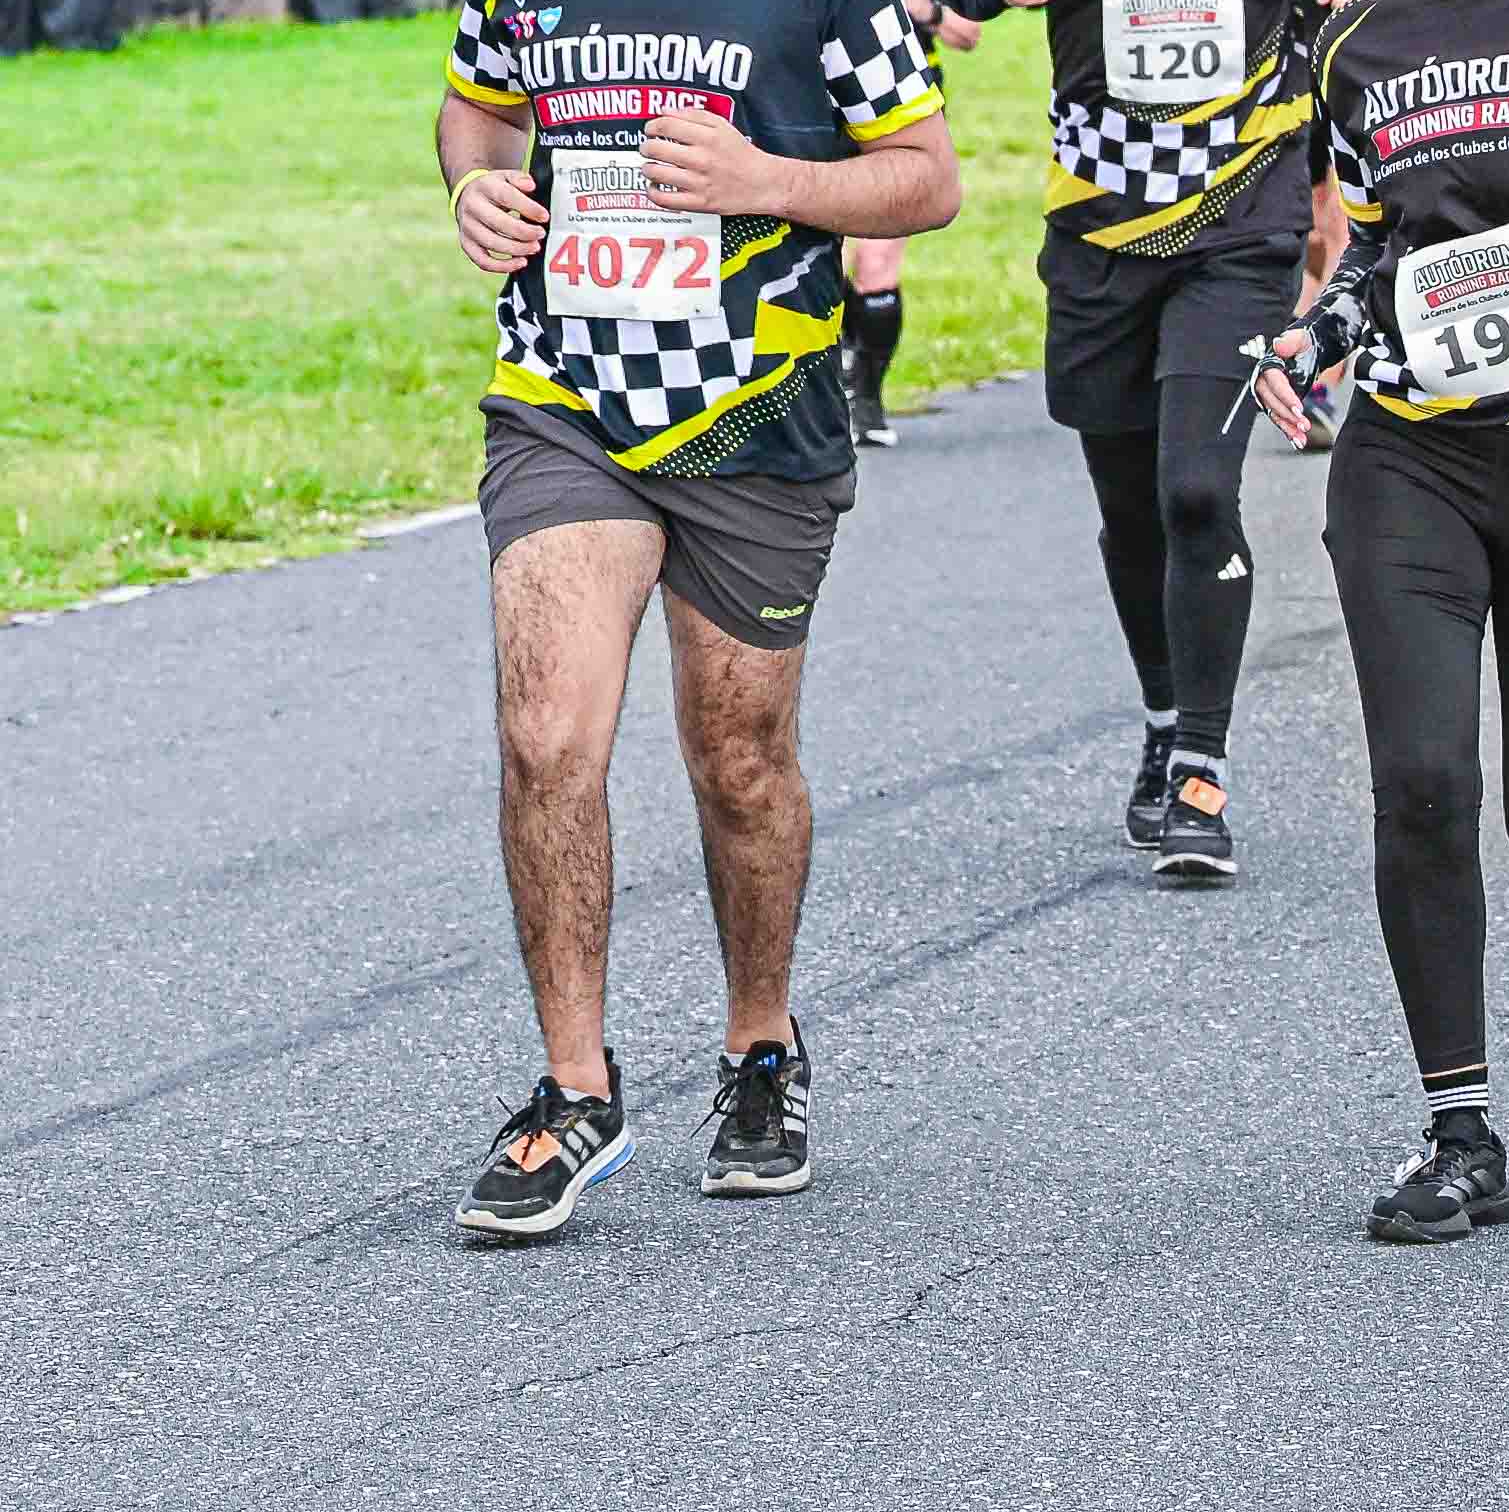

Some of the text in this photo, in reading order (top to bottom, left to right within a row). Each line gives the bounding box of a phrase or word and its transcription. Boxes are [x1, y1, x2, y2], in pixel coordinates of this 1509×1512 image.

[519, 23, 753, 91] AUTÓDROMO
[1128, 40, 1221, 80] 120
[547, 88, 641, 123] RUNNING
[575, 131, 591, 146] de
[593, 131, 613, 146] los
[615, 130, 649, 146] Club
[1387, 105, 1475, 150] RUNNING
[569, 160, 653, 193] AUTÓDR
[1381, 157, 1413, 178] Carrera
[1414, 151, 1430, 166] de
[1431, 147, 1450, 162] los
[1451, 140, 1496, 157] Clubes
[586, 194, 660, 209] RUNNING RA
[549, 235, 711, 289] 4072
[1436, 274, 1487, 303] RUNNING
[1421, 313, 1430, 321] La
[1430, 306, 1457, 317] Carrera
[1457, 302, 1466, 310] de
[1467, 299, 1478, 307] los
[1478, 292, 1503, 303] Clubes
